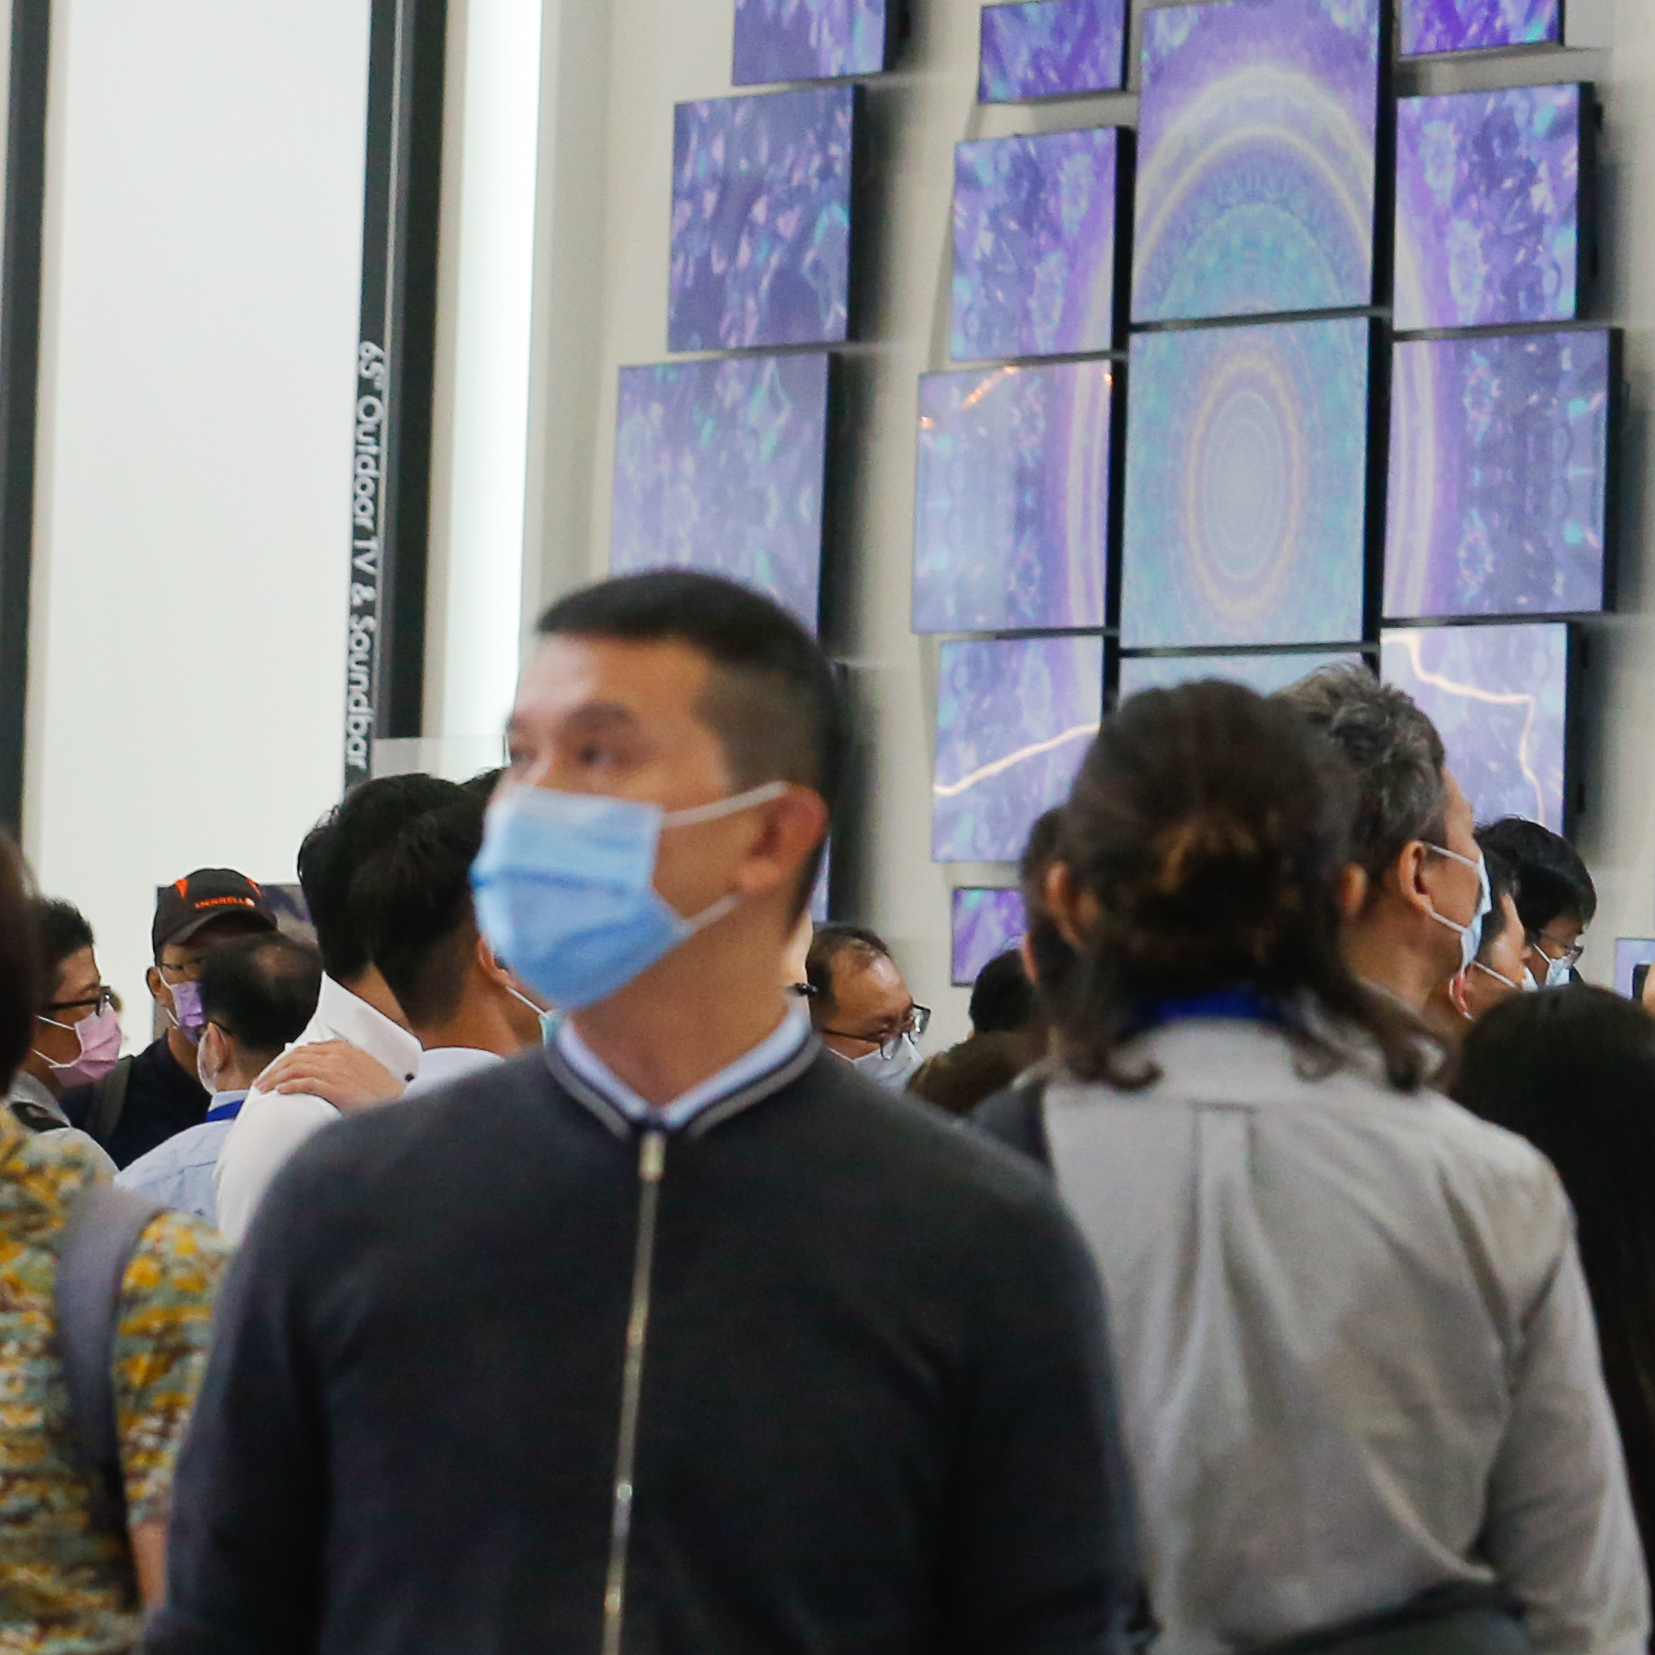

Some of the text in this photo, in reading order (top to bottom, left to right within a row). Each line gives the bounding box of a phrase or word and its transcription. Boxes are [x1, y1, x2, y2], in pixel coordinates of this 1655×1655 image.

[353, 395, 382, 531] Outdoor
[351, 582, 377, 607] &
[353, 535, 379, 576] TV
[346, 613, 377, 770] Soundbar
